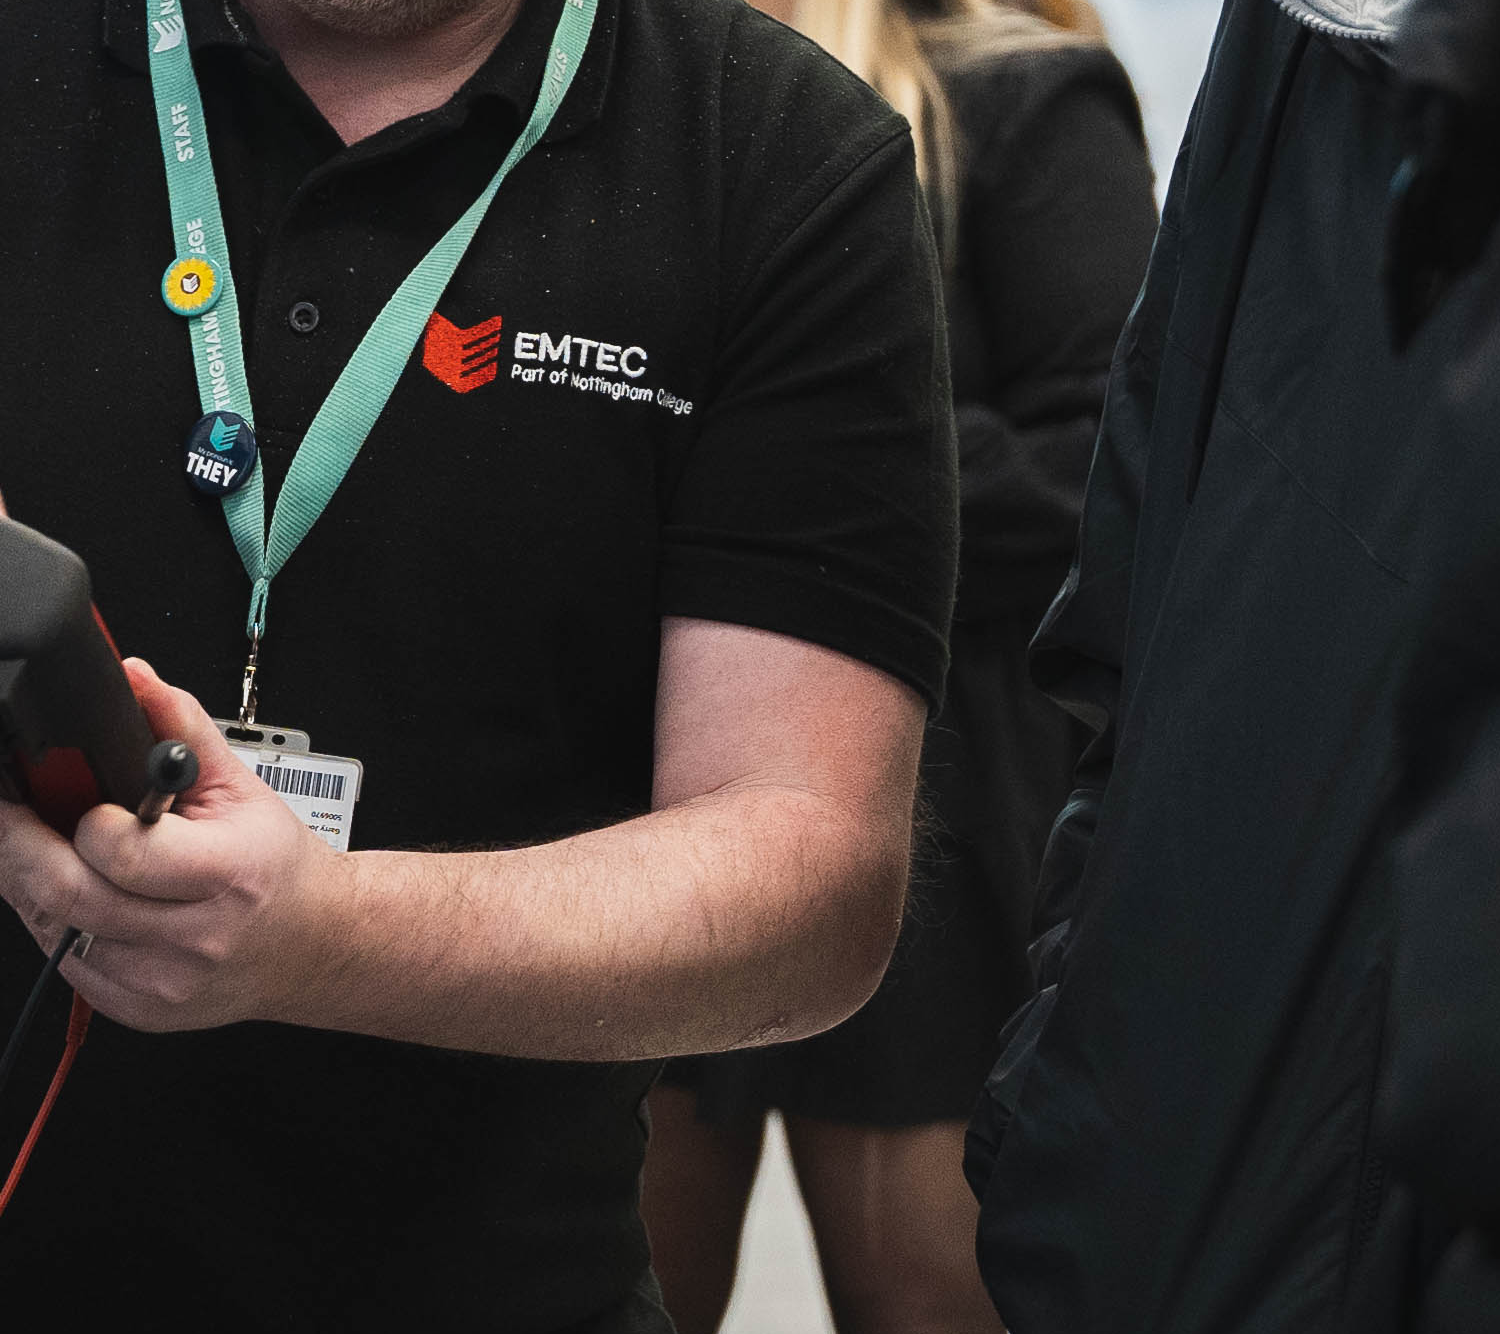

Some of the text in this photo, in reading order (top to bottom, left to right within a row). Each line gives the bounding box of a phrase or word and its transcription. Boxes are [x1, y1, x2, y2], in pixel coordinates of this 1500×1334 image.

[171, 103, 196, 163] STAFF
[201, 310, 232, 411] TINGHAM
[514, 331, 648, 379] EMTEC
[510, 363, 694, 415] Part of Nottingham Cege
[186, 451, 238, 487] THEY
